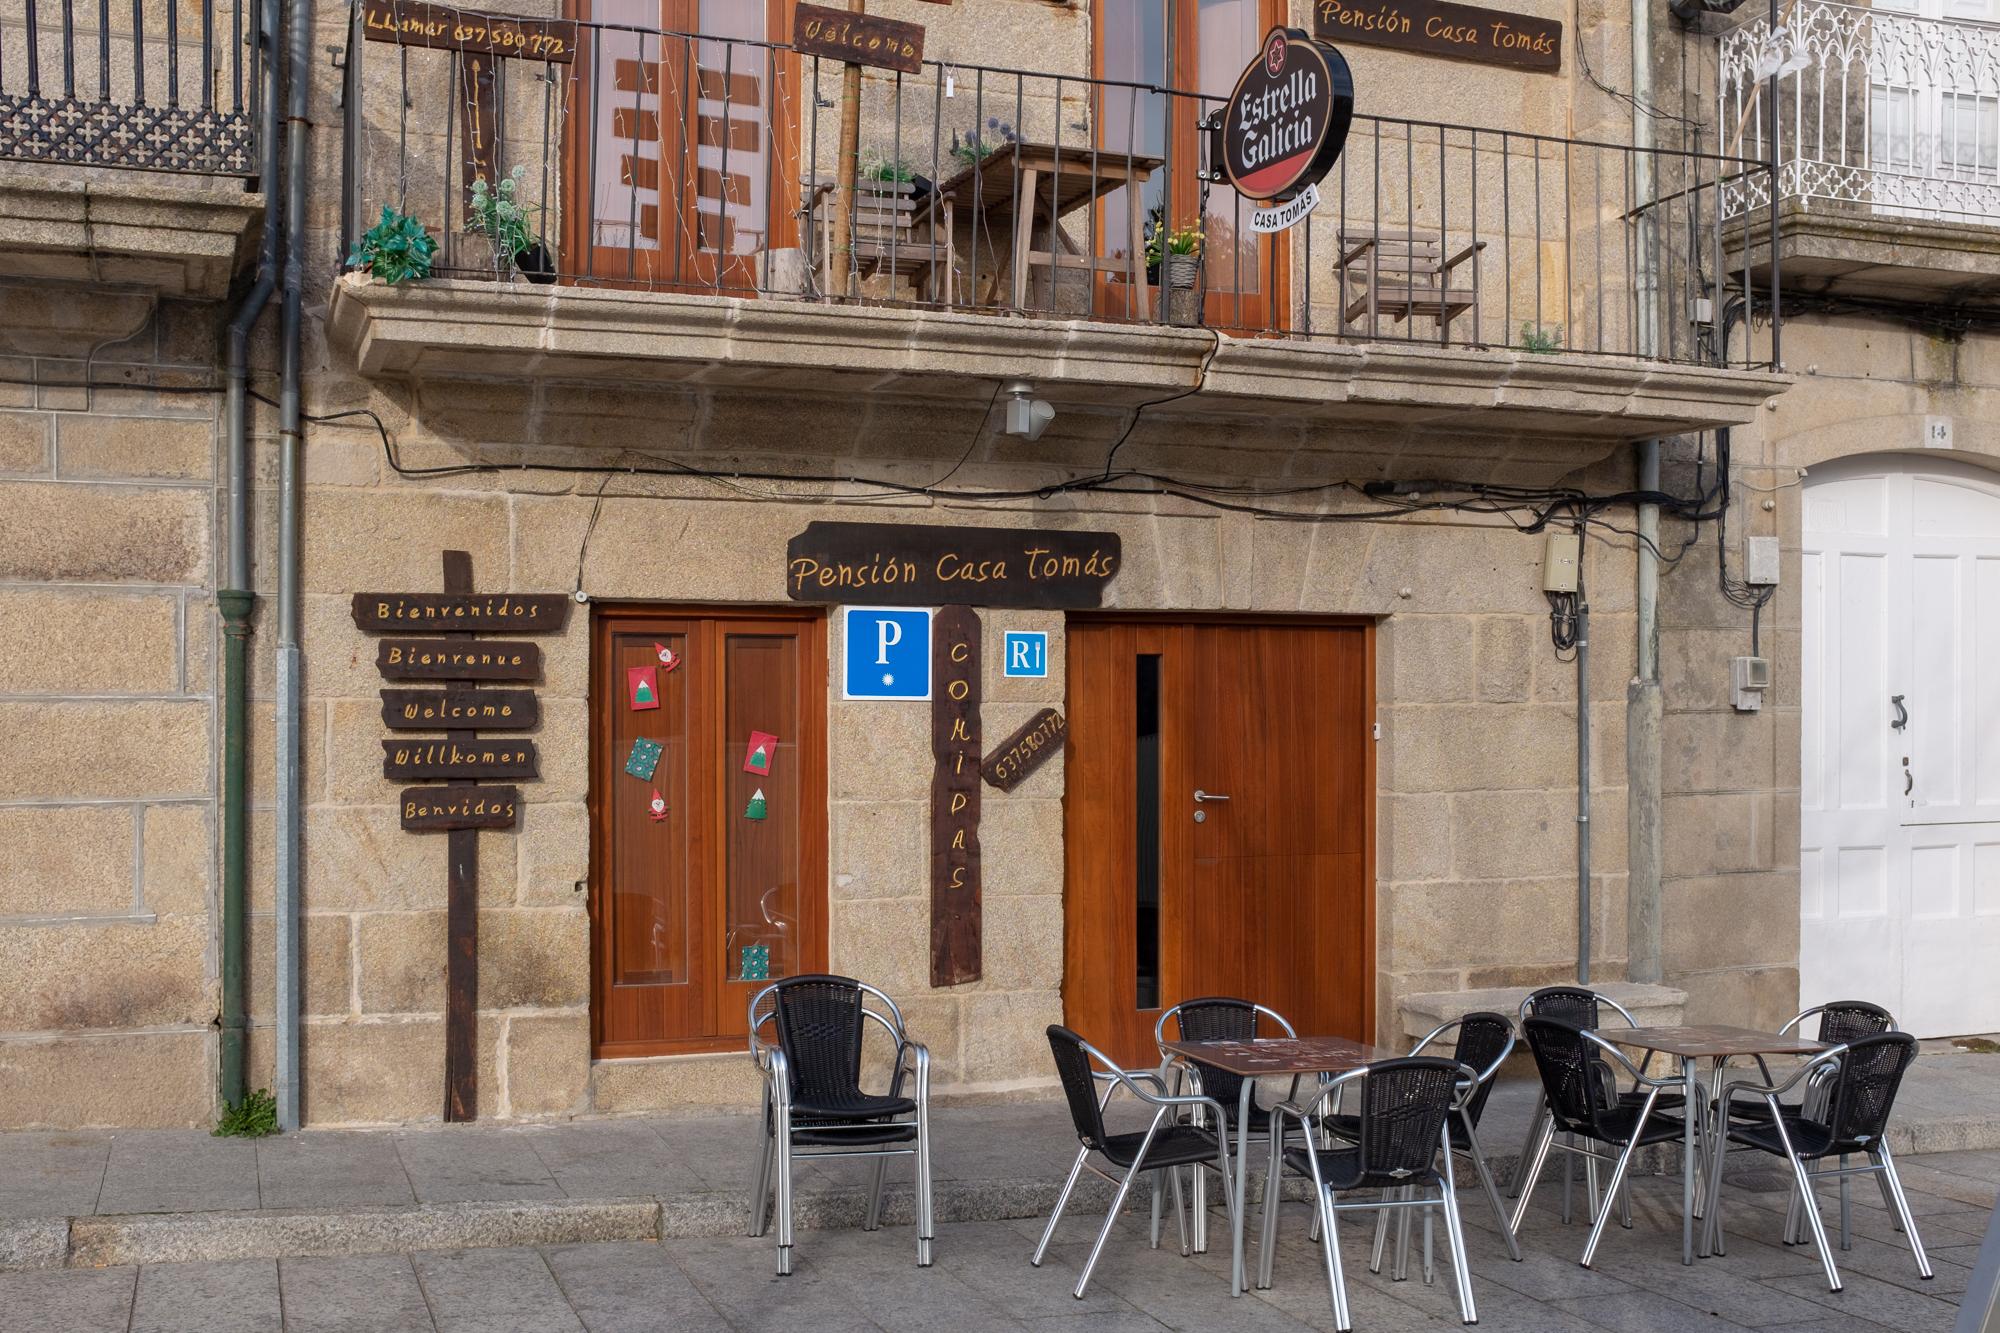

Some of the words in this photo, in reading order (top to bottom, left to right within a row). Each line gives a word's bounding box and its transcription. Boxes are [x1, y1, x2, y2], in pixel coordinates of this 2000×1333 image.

[1318, 0, 1410, 33] Pensión
[1425, 17, 1478, 43] Casa
[1490, 21, 1556, 54] Tomás
[1239, 68, 1317, 131] Estrella
[1241, 110, 1313, 169] Galicia
[1254, 211, 1278, 228] CASA
[1280, 191, 1312, 226] TOMÁS
[790, 553, 916, 590] Pensión
[936, 553, 1007, 582] Casa
[1024, 547, 1113, 580] Tomás
[377, 598, 538, 619] Bienvenidos
[388, 647, 522, 665] Bienvenue
[874, 619, 902, 665] P
[404, 699, 512, 720] Welcome
[395, 745, 526, 766] Willkomen
[995, 713, 1065, 779] 637580772
[405, 800, 514, 819] Benvidos
